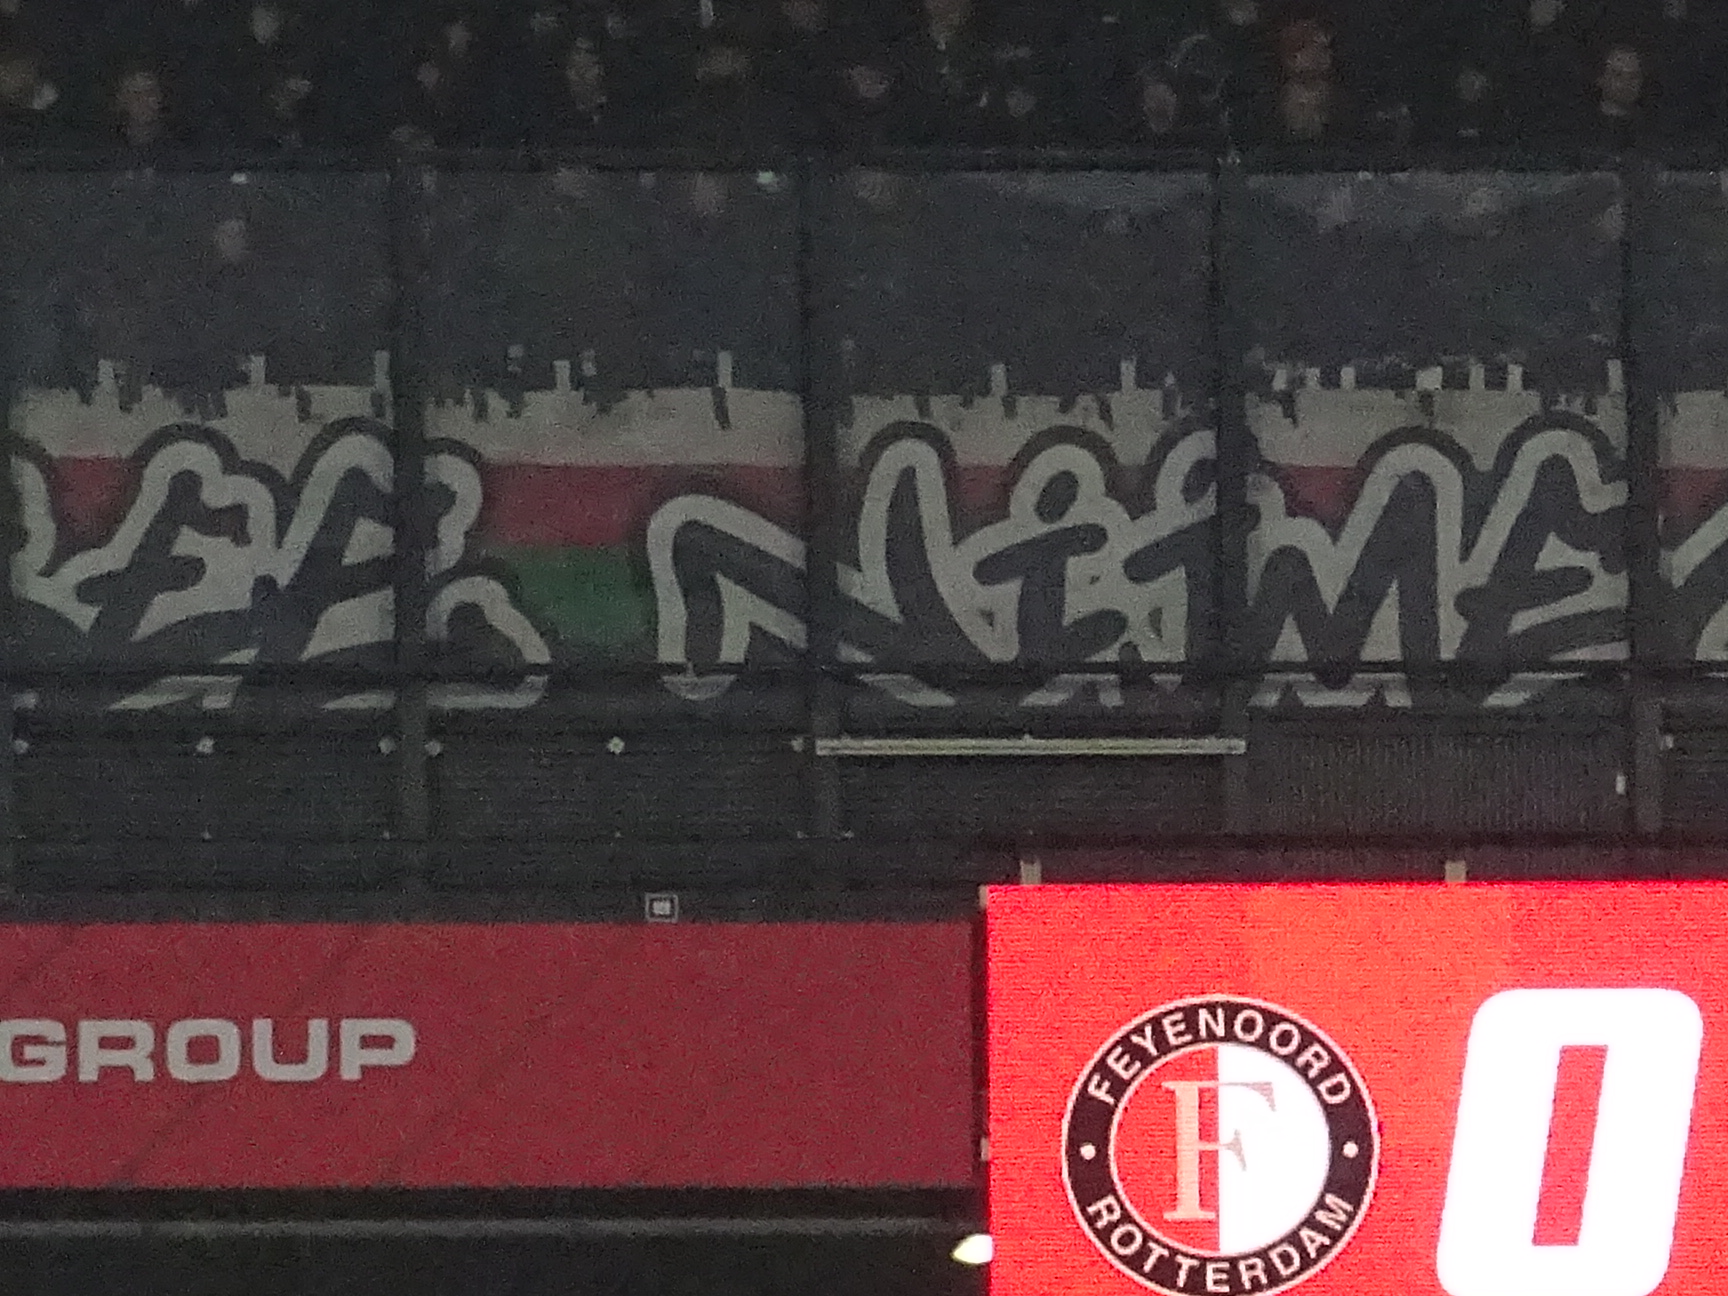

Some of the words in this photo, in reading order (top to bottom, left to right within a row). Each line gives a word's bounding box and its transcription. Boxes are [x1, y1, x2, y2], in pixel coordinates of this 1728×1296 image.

[0, 1018, 417, 1083] GROUP
[1087, 1007, 1352, 1106] FEYENOORD
[1161, 1080, 1277, 1220] F
[1086, 1192, 1355, 1293] ROTTERDAM
